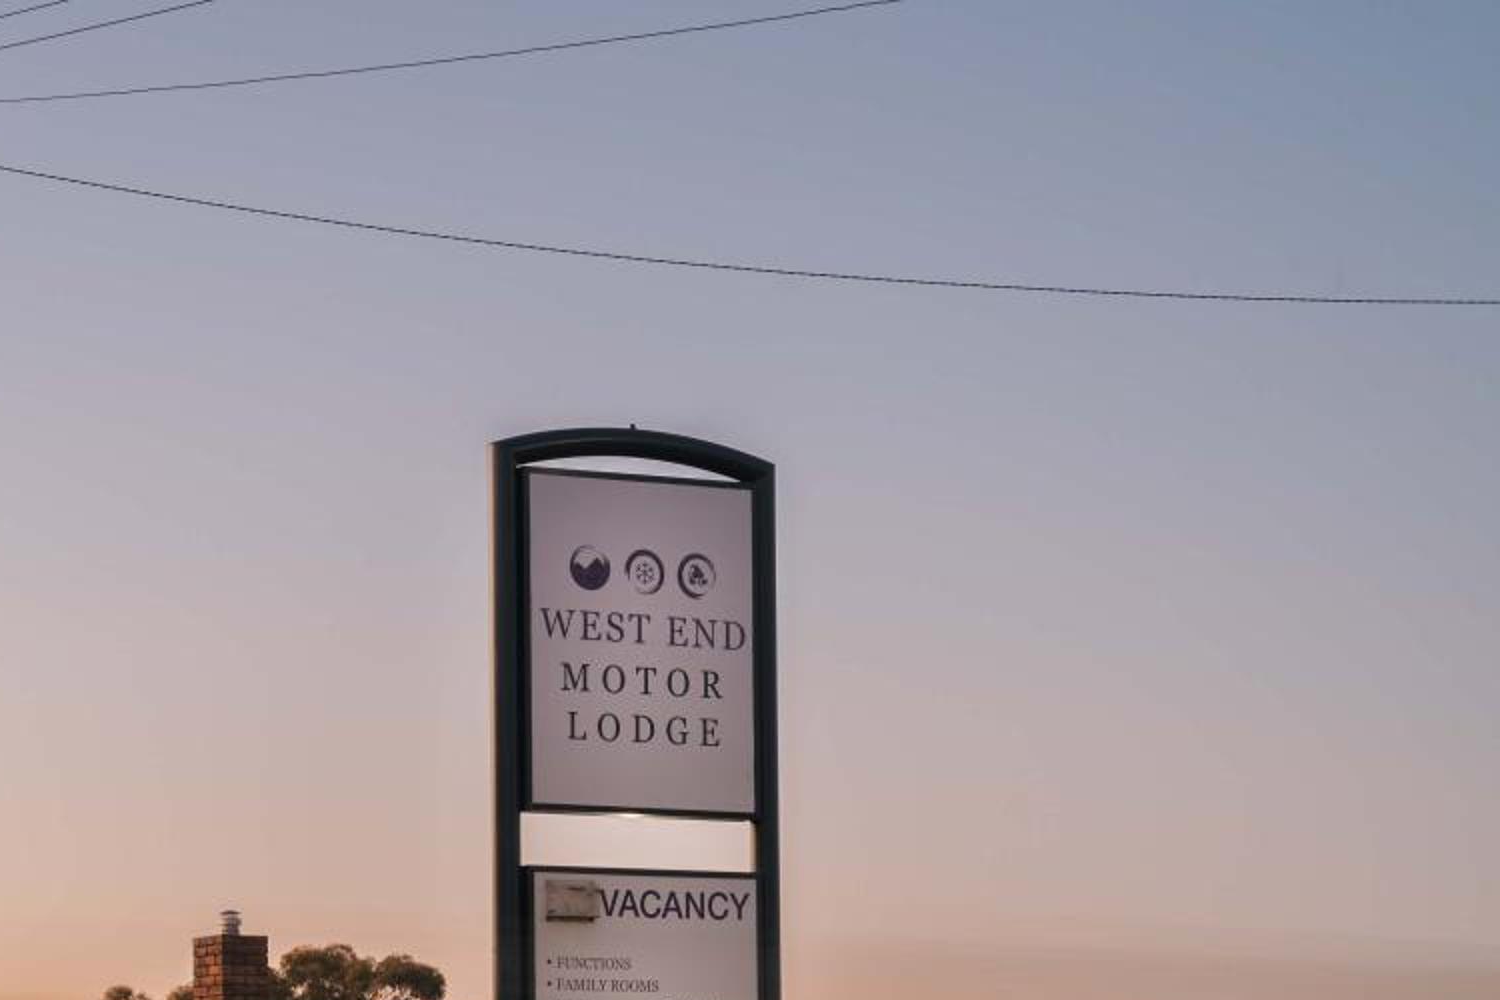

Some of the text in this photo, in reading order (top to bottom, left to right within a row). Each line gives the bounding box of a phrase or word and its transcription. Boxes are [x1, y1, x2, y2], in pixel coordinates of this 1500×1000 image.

[540, 607, 746, 651] WEST END
[560, 661, 723, 699] MOTOR
[568, 711, 721, 747] LODGE
[599, 889, 751, 921] VACANCY
[556, 957, 632, 970] FUNCTIONS
[556, 979, 659, 993] FAMILY ROOMS
